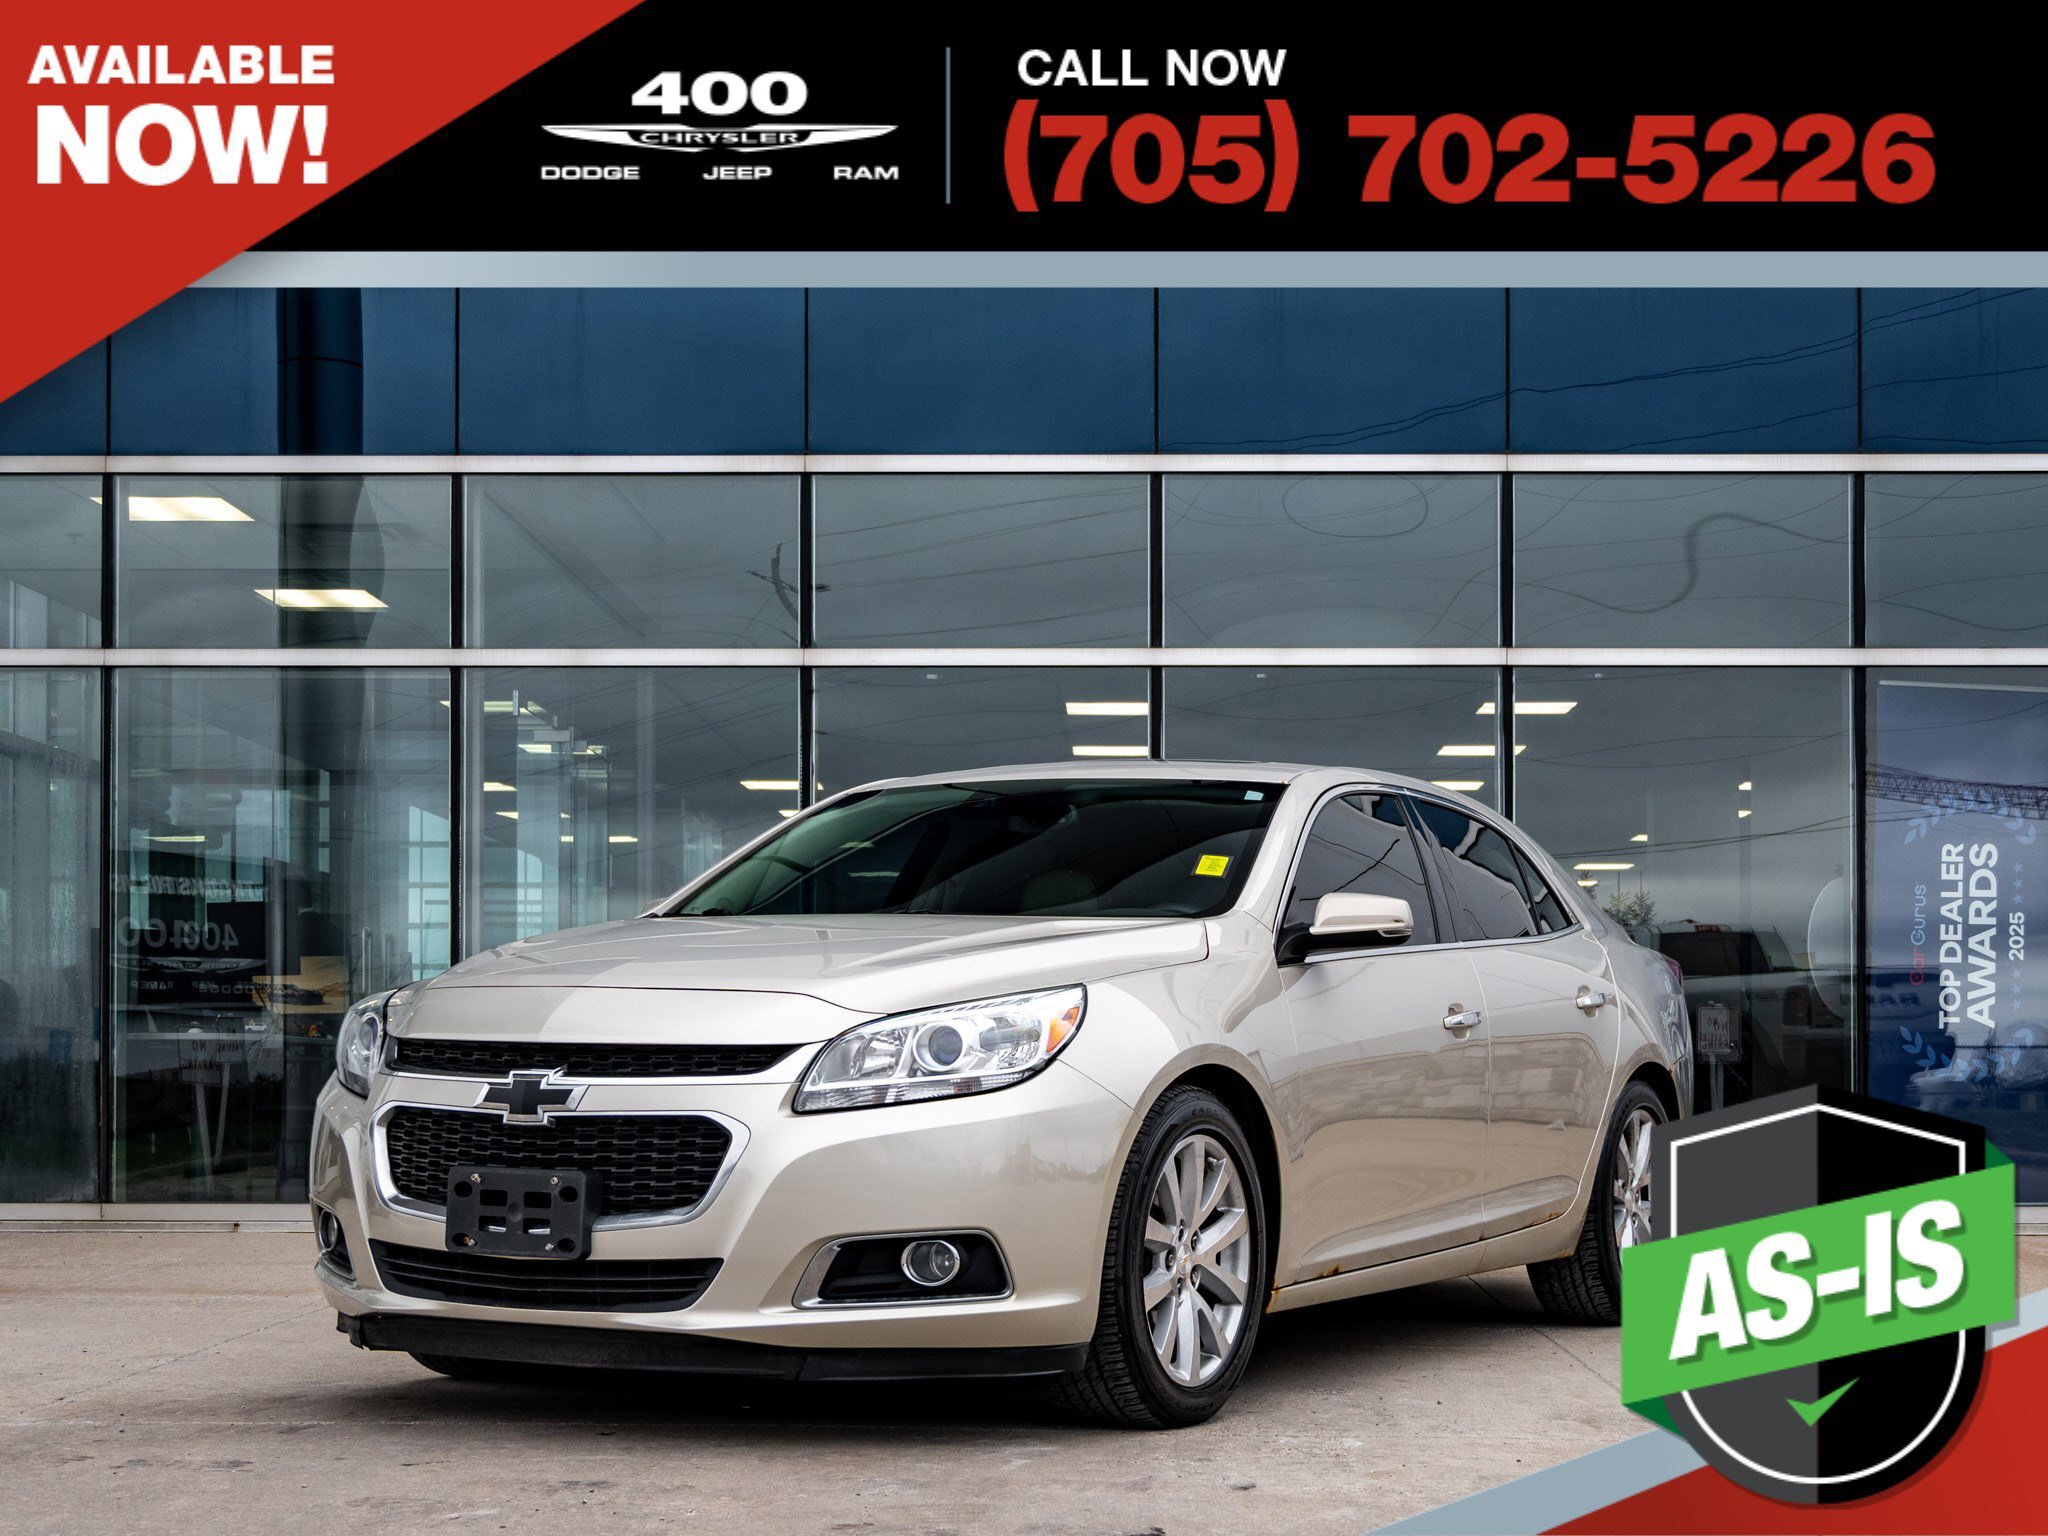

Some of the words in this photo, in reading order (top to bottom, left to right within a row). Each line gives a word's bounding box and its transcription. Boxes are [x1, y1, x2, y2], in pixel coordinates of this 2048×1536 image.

[1940, 843, 1964, 963] DEALER
[1967, 843, 1998, 1029] AWARDS
[2009, 911, 2025, 961] 2025
[1938, 969, 1961, 1029] TOP
